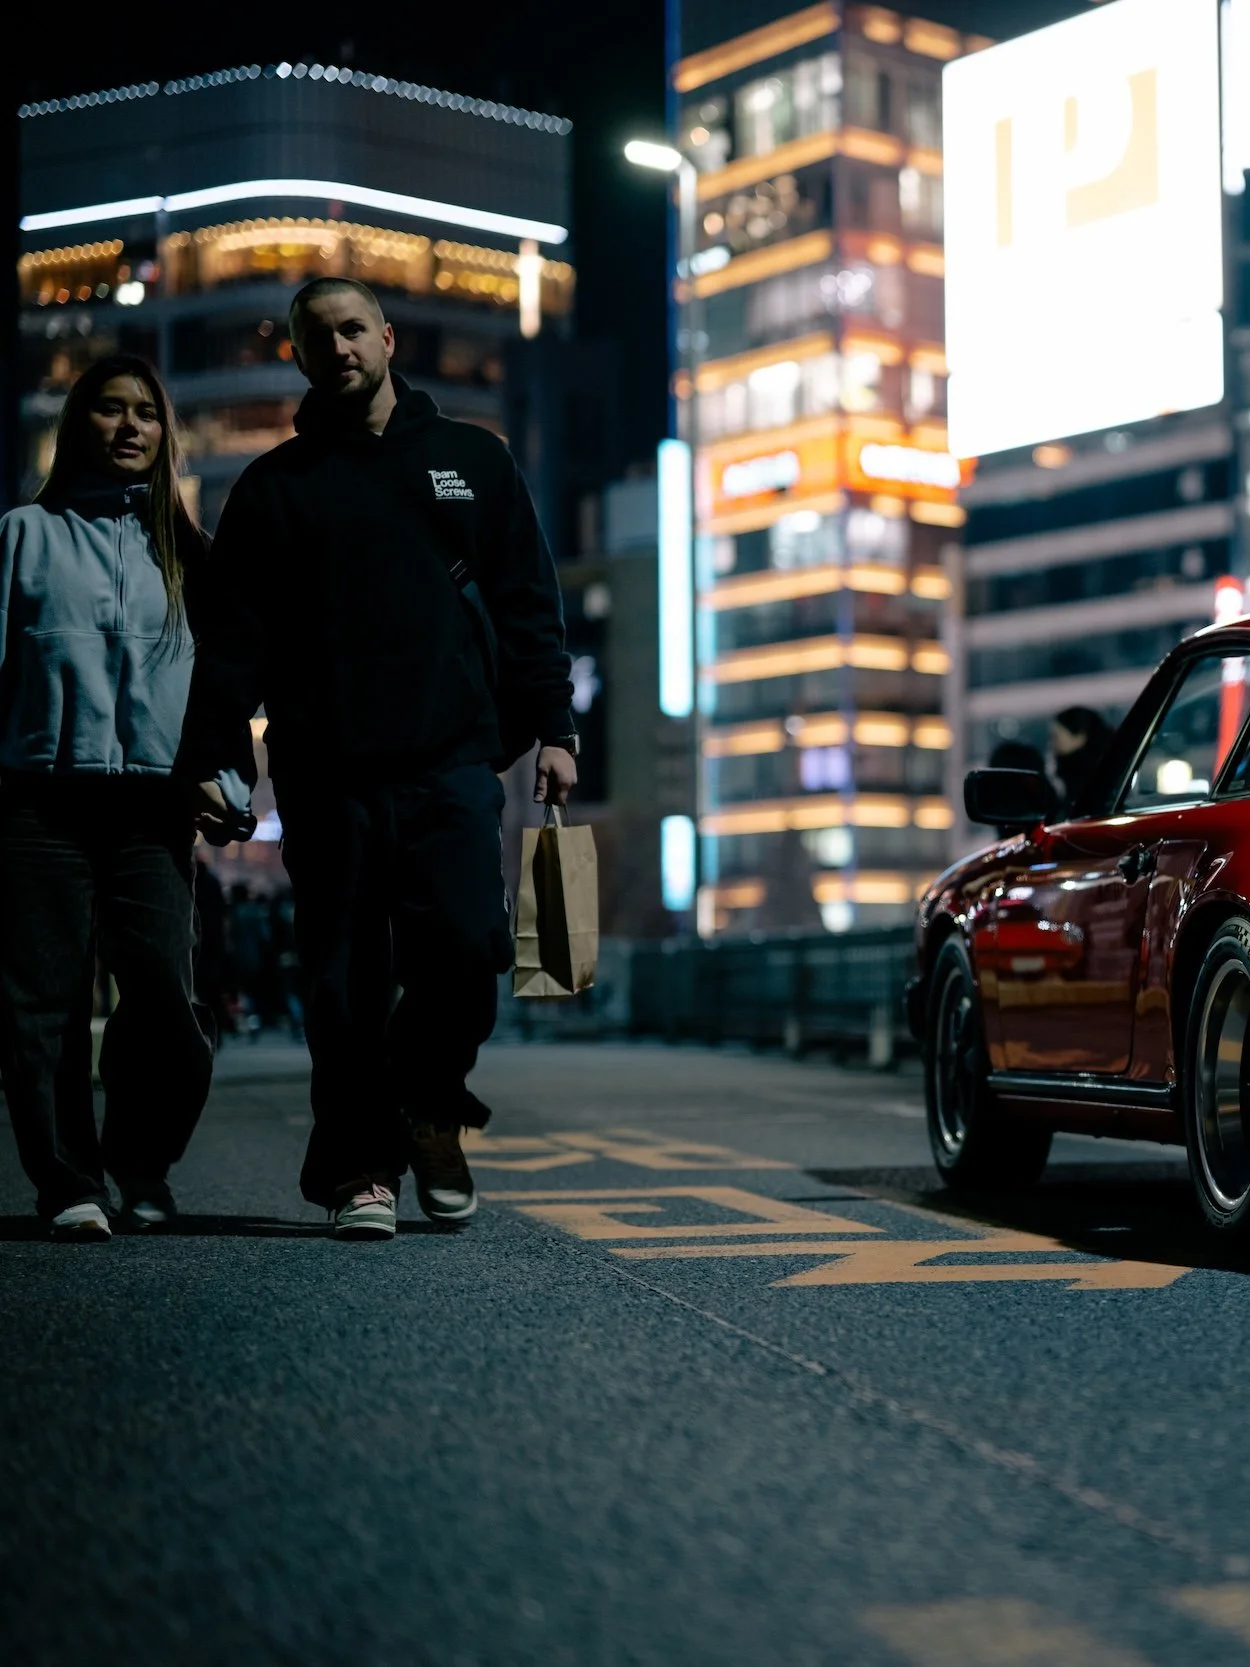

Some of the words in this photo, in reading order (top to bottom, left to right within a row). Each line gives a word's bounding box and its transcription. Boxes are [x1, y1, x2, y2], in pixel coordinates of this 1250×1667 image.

[428, 470, 458, 479] Team
[432, 478, 466, 488] Loose
[435, 486, 474, 497] Screws.
